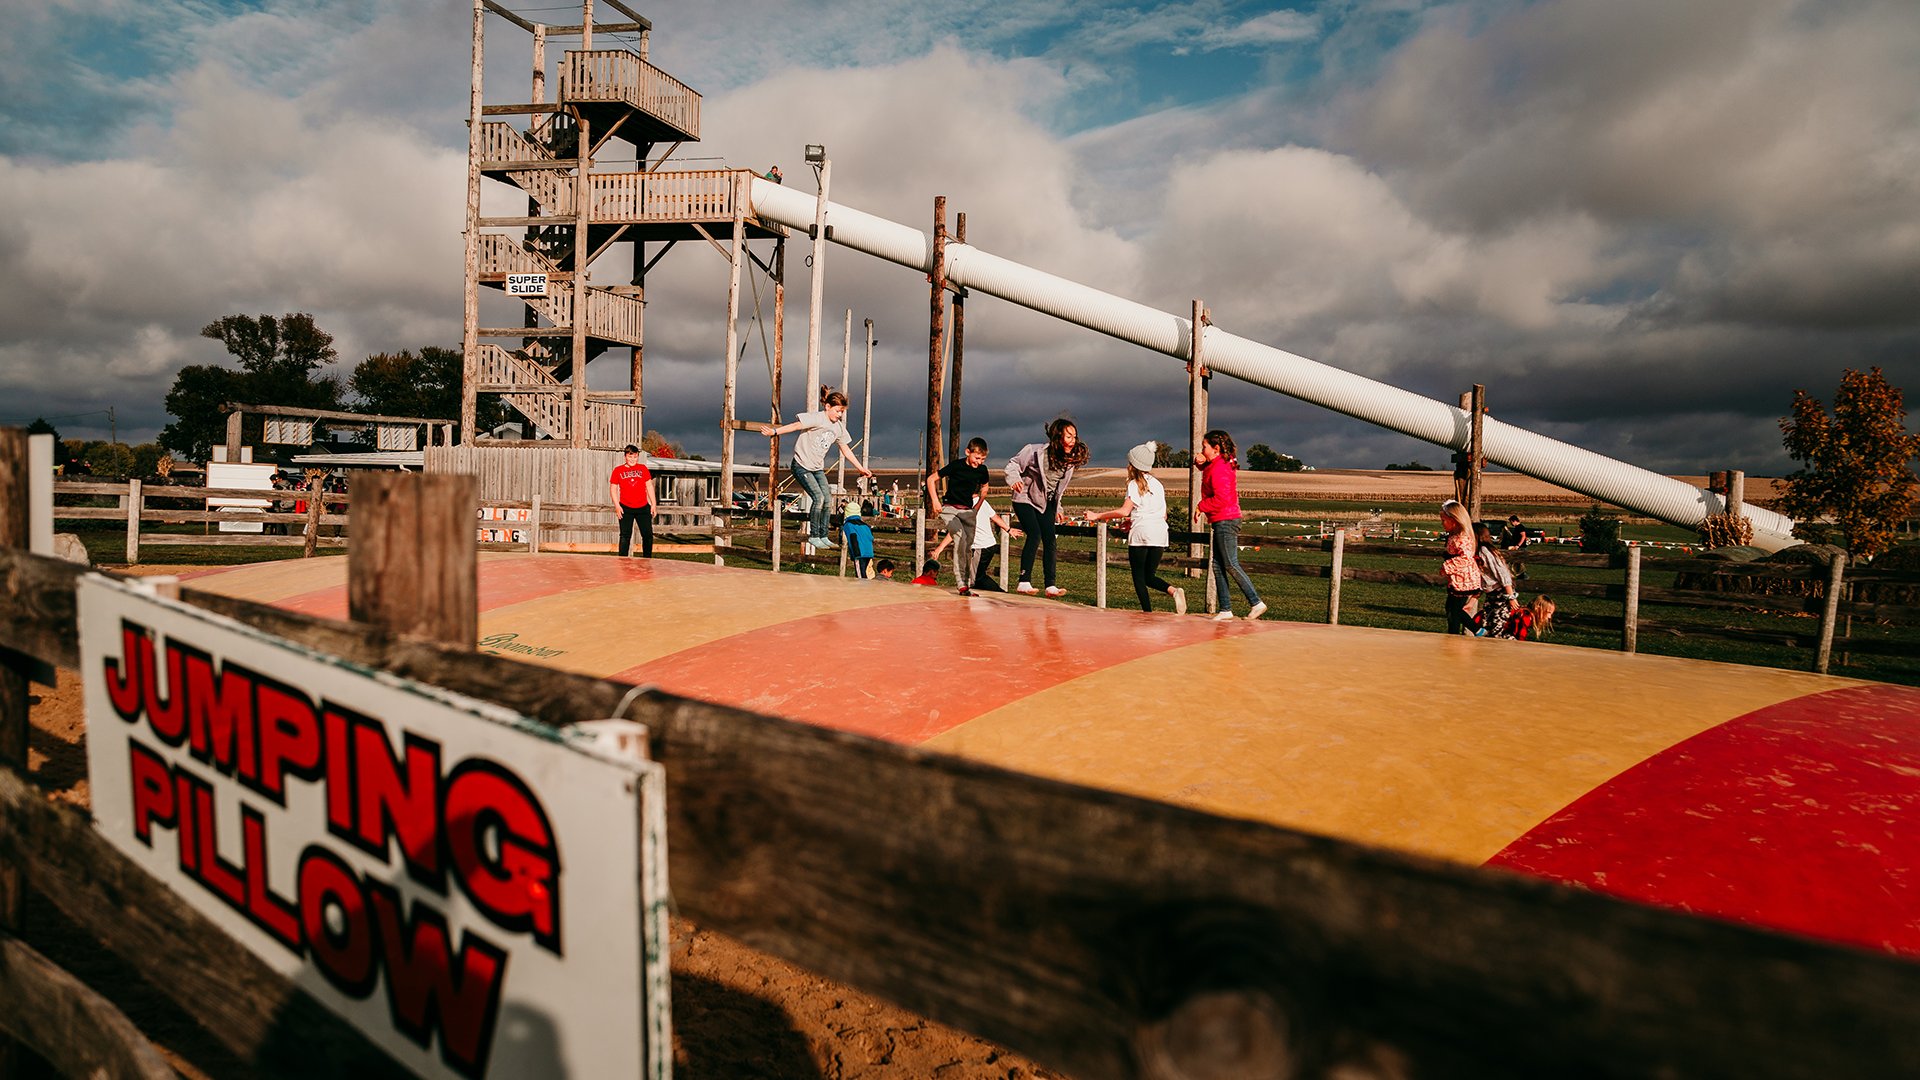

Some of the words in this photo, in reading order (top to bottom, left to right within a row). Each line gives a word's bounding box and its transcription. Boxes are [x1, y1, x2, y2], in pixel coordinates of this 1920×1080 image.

[508, 276, 546, 284] SUPER
[511, 285, 544, 293] SLIDE
[104, 618, 564, 958] JUMPING
[127, 736, 509, 1080] PILLOW
